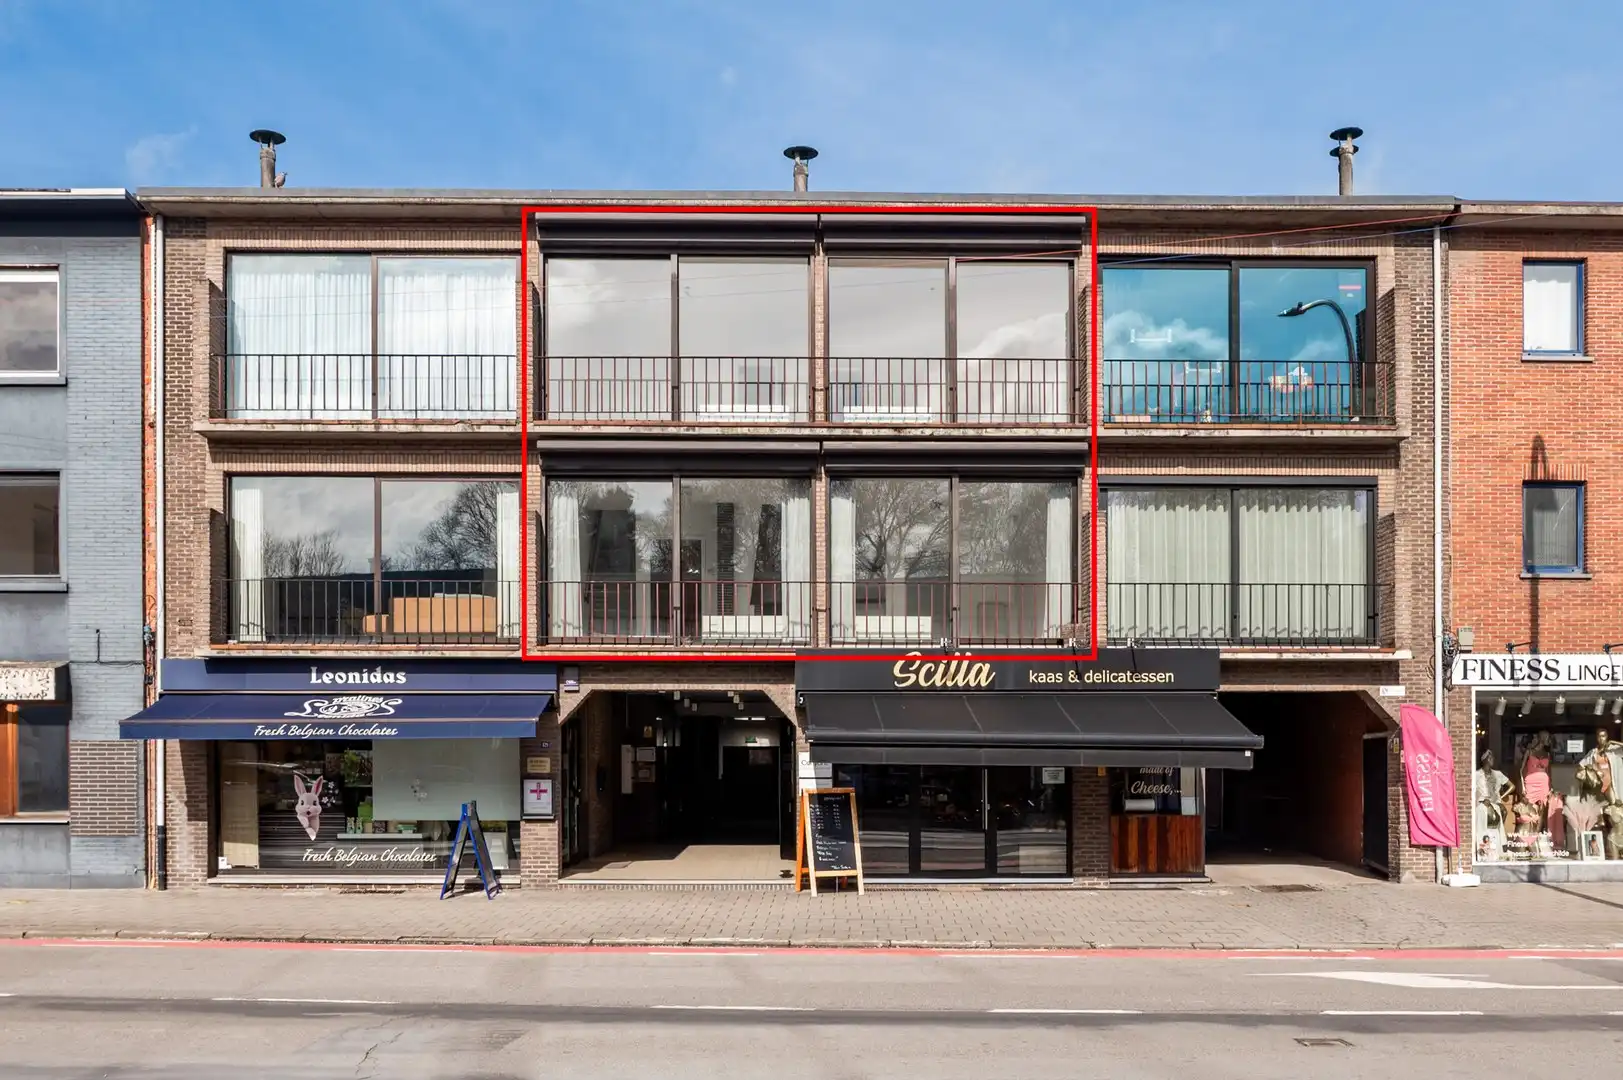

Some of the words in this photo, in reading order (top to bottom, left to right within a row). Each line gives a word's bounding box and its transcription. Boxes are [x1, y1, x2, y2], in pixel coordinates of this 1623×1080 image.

[310, 666, 407, 685] Leonidas
[893, 651, 995, 689] Scilla
[1029, 669, 1063, 684] kaas
[1068, 669, 1081, 684] &
[1084, 669, 1175, 684] delicatessen
[1460, 658, 1560, 682] FINESS
[1568, 665, 1623, 682] LINGE
[254, 724, 287, 737] Fresh
[288, 724, 336, 739] Belgian
[338, 723, 399, 737] Chocolates
[302, 847, 334, 862] Fresh
[334, 847, 379, 867] Belgian
[380, 847, 437, 862] Chocolates
